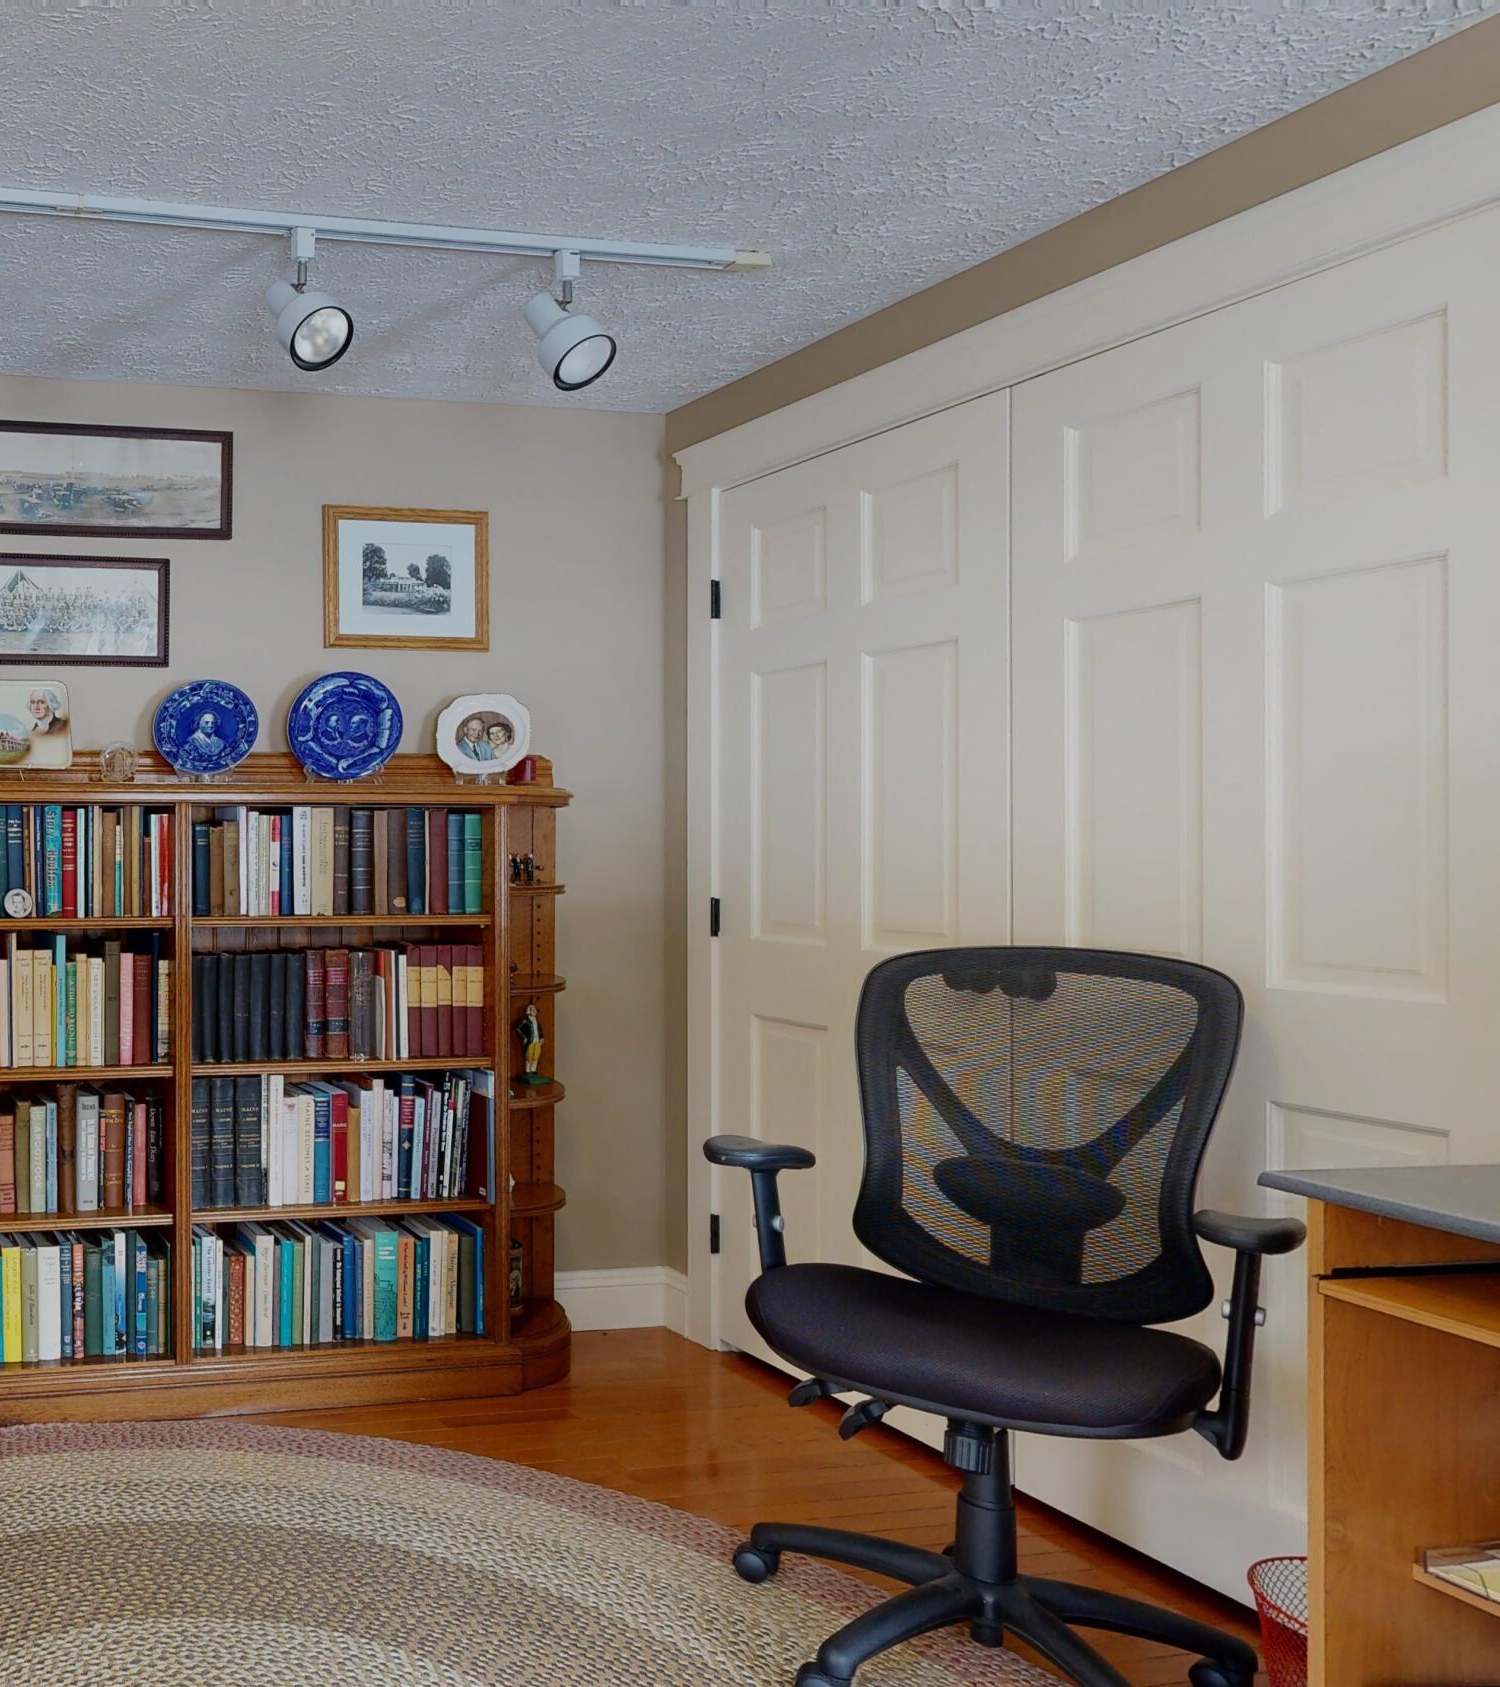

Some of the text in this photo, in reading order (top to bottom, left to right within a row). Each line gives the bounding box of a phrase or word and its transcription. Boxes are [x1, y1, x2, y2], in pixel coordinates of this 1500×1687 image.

[33, 1125, 43, 1190] AROOSTOOK
[148, 1108, 157, 1163] Down East Diary
